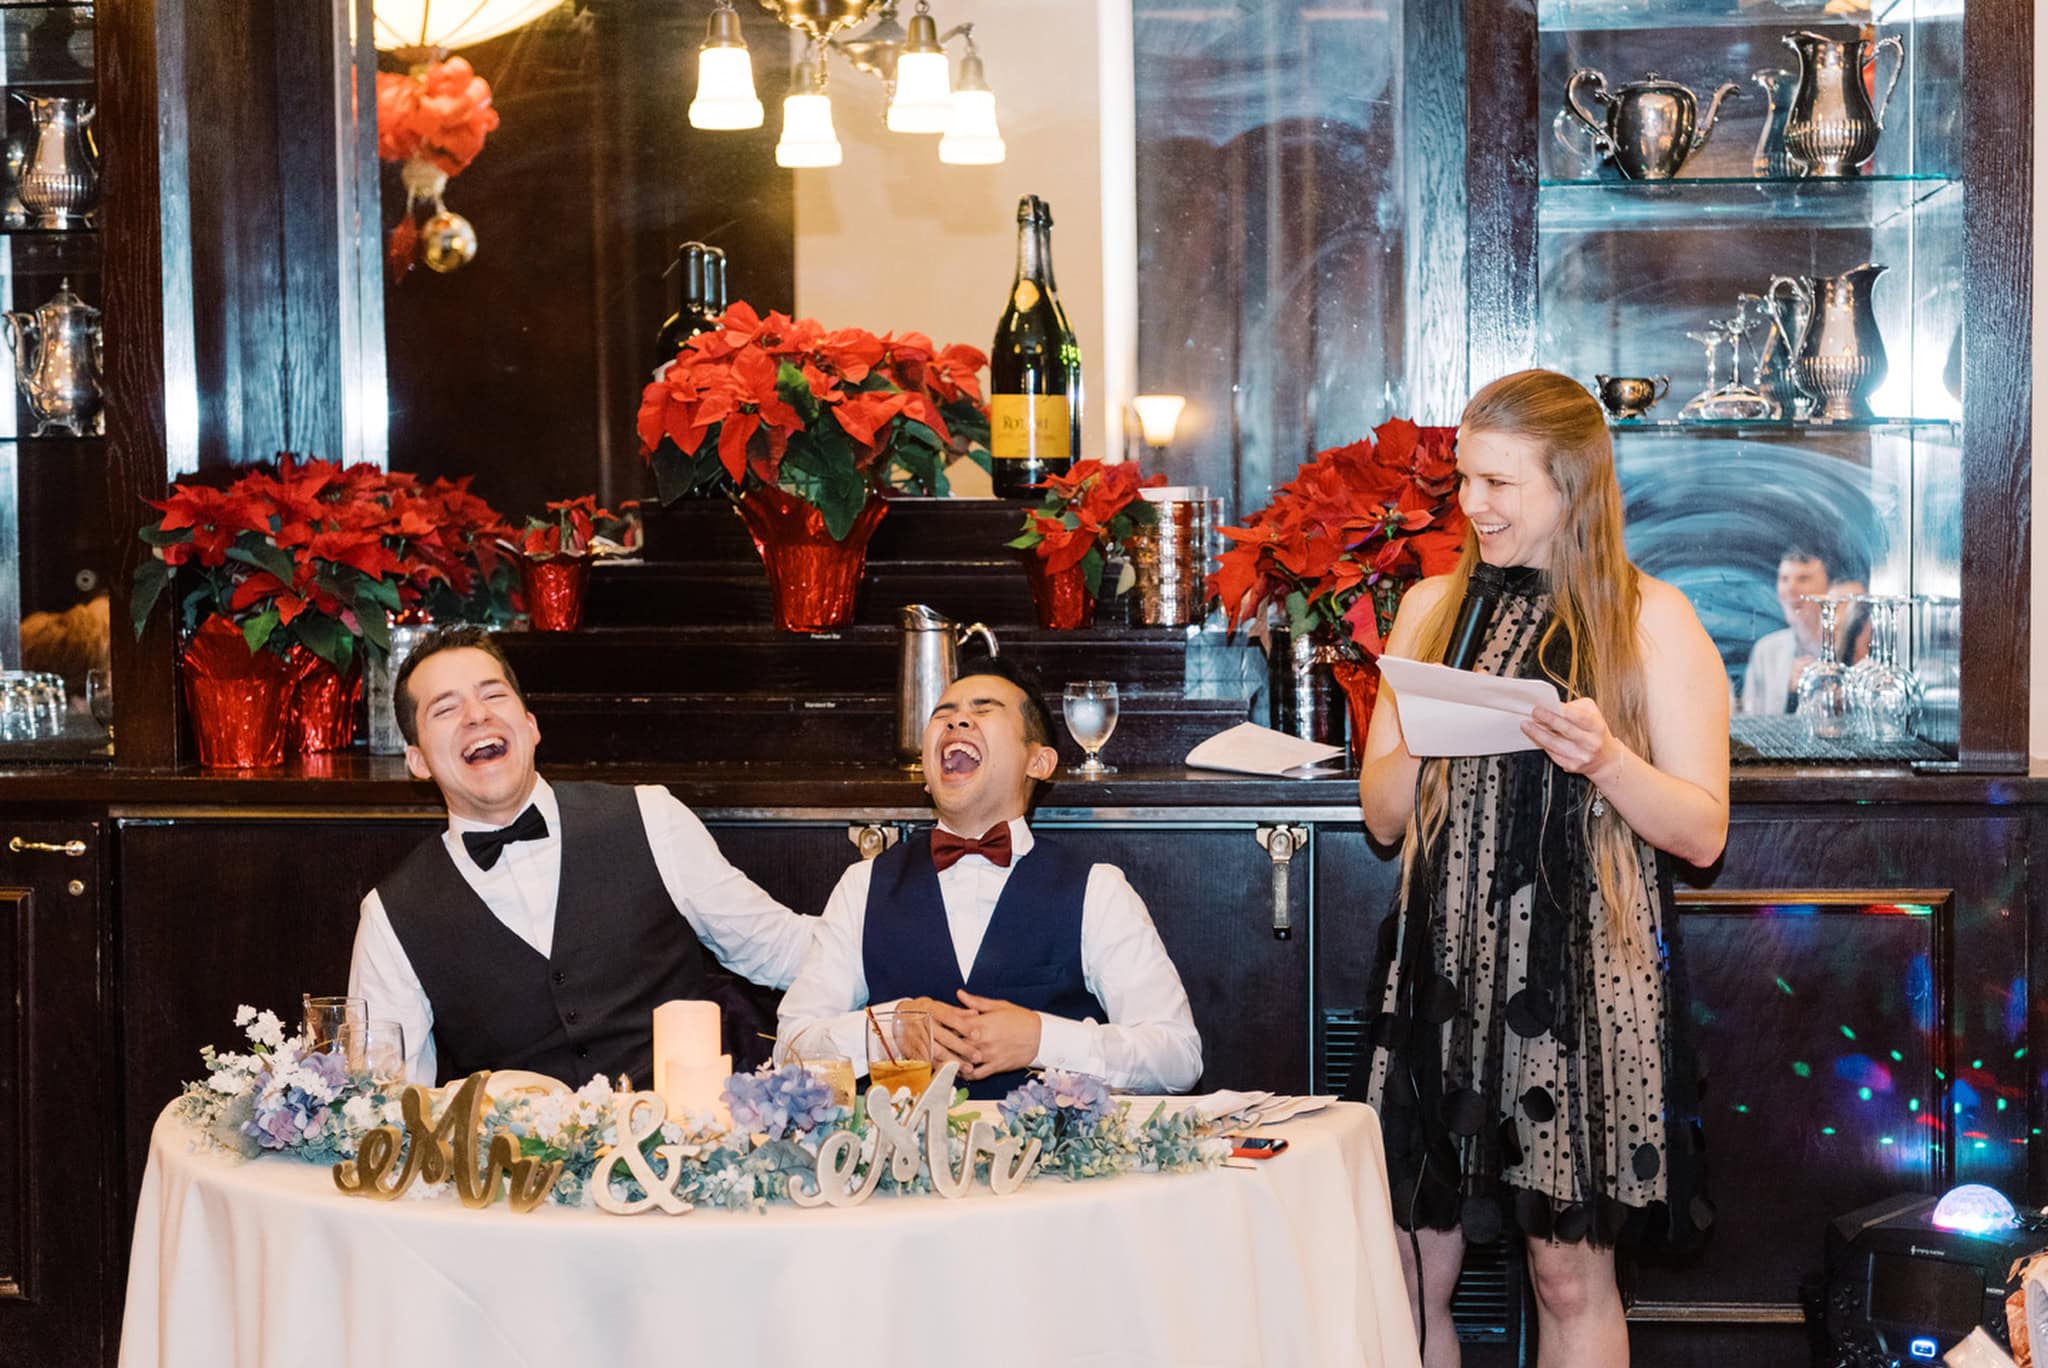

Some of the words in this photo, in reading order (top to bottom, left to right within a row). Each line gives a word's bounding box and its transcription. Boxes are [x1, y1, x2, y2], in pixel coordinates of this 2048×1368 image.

[1003, 415, 1048, 430] ROTRI
[333, 1070, 563, 1213] Mr
[591, 1091, 701, 1216] &
[788, 1061, 1042, 1207] Mr
